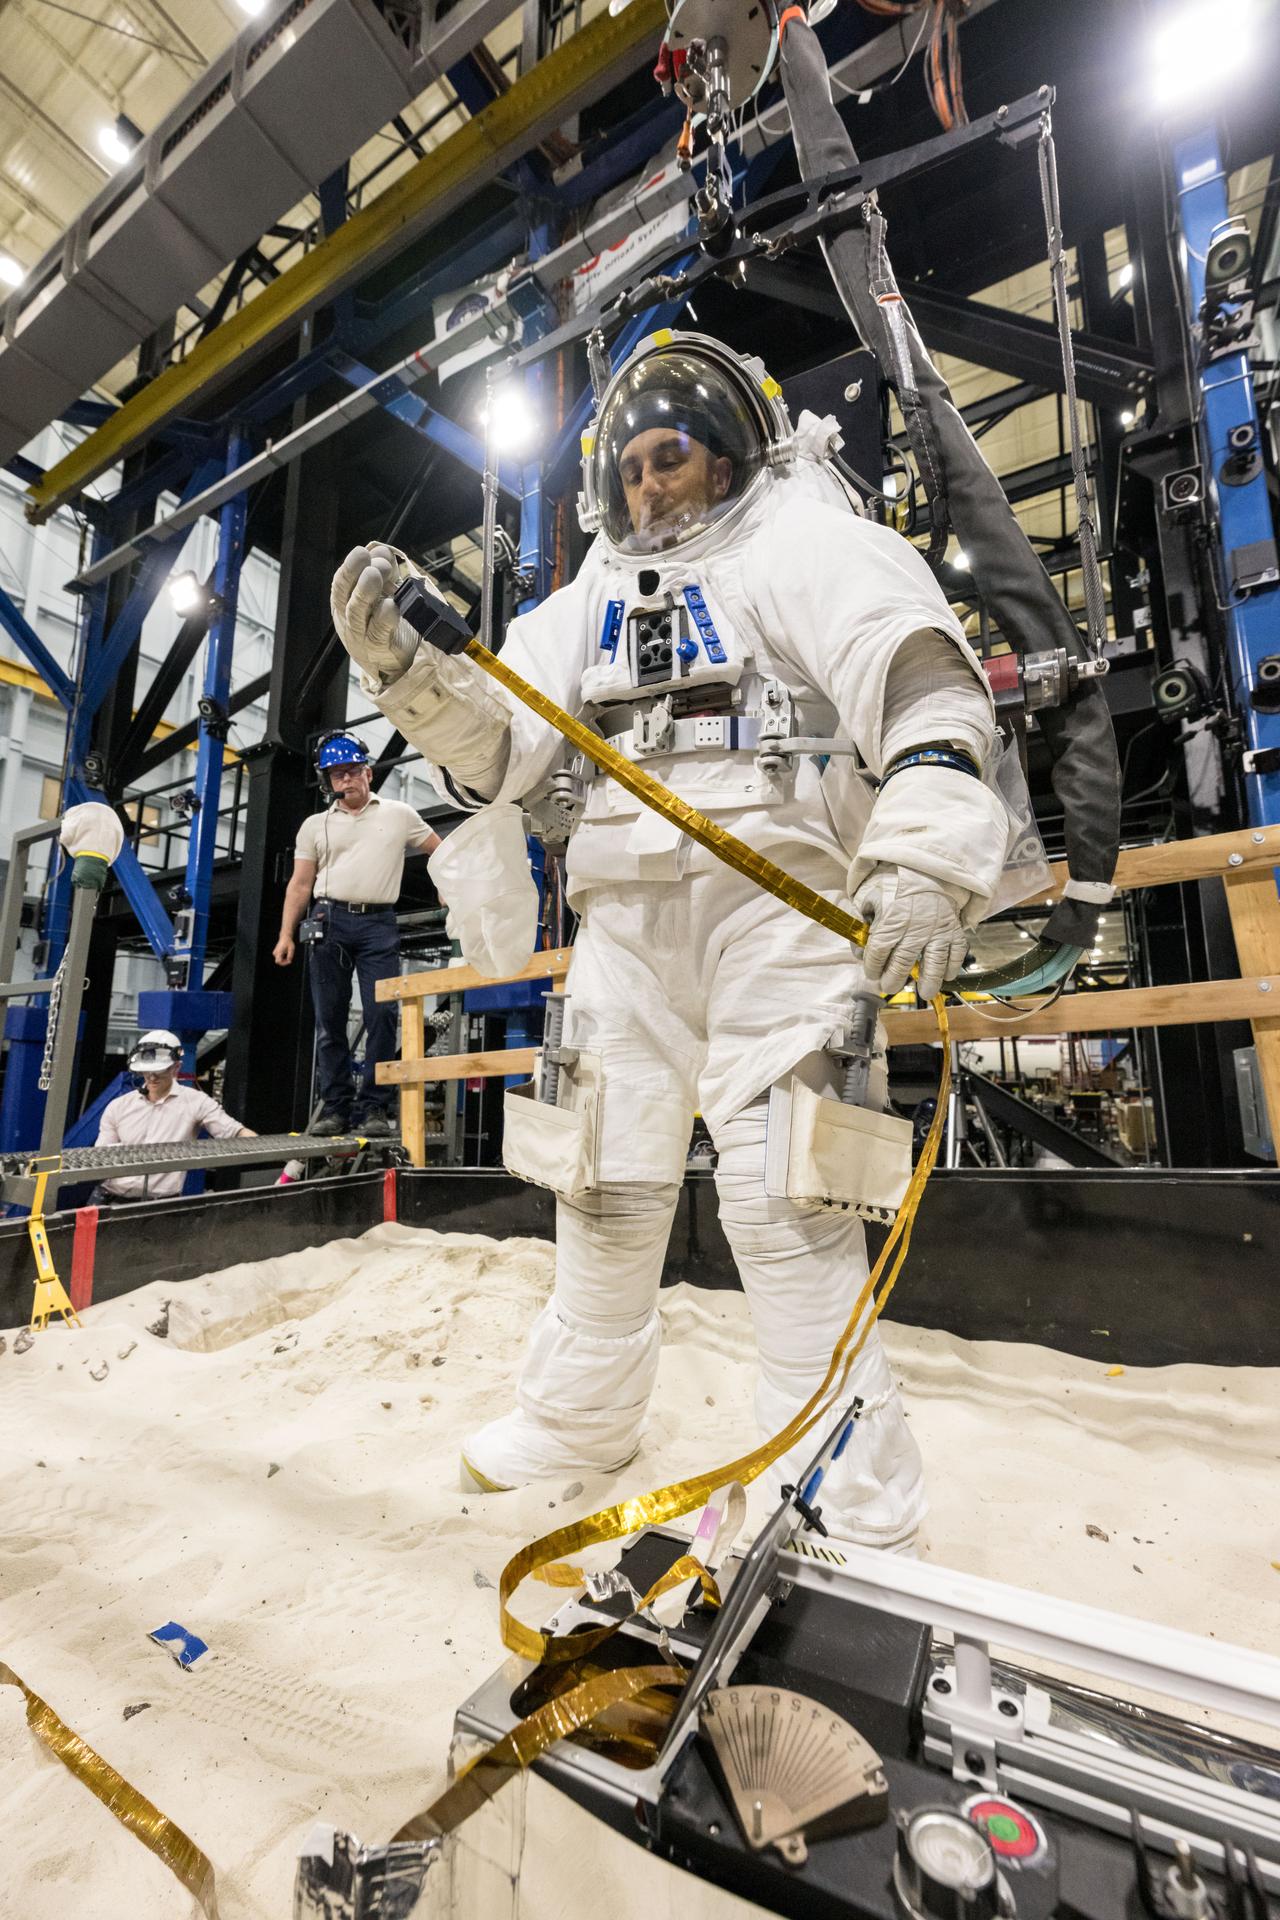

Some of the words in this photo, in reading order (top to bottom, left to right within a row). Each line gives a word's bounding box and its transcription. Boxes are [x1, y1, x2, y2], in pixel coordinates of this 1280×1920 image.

[638, 212, 669, 242] System
[730, 1692, 740, 1705] 8
[751, 1690, 760, 1703] 7
[791, 1698, 802, 1712] 5
[811, 1708, 822, 1720] 4
[829, 1720, 841, 1734] 3
[846, 1738, 860, 1751] 2
